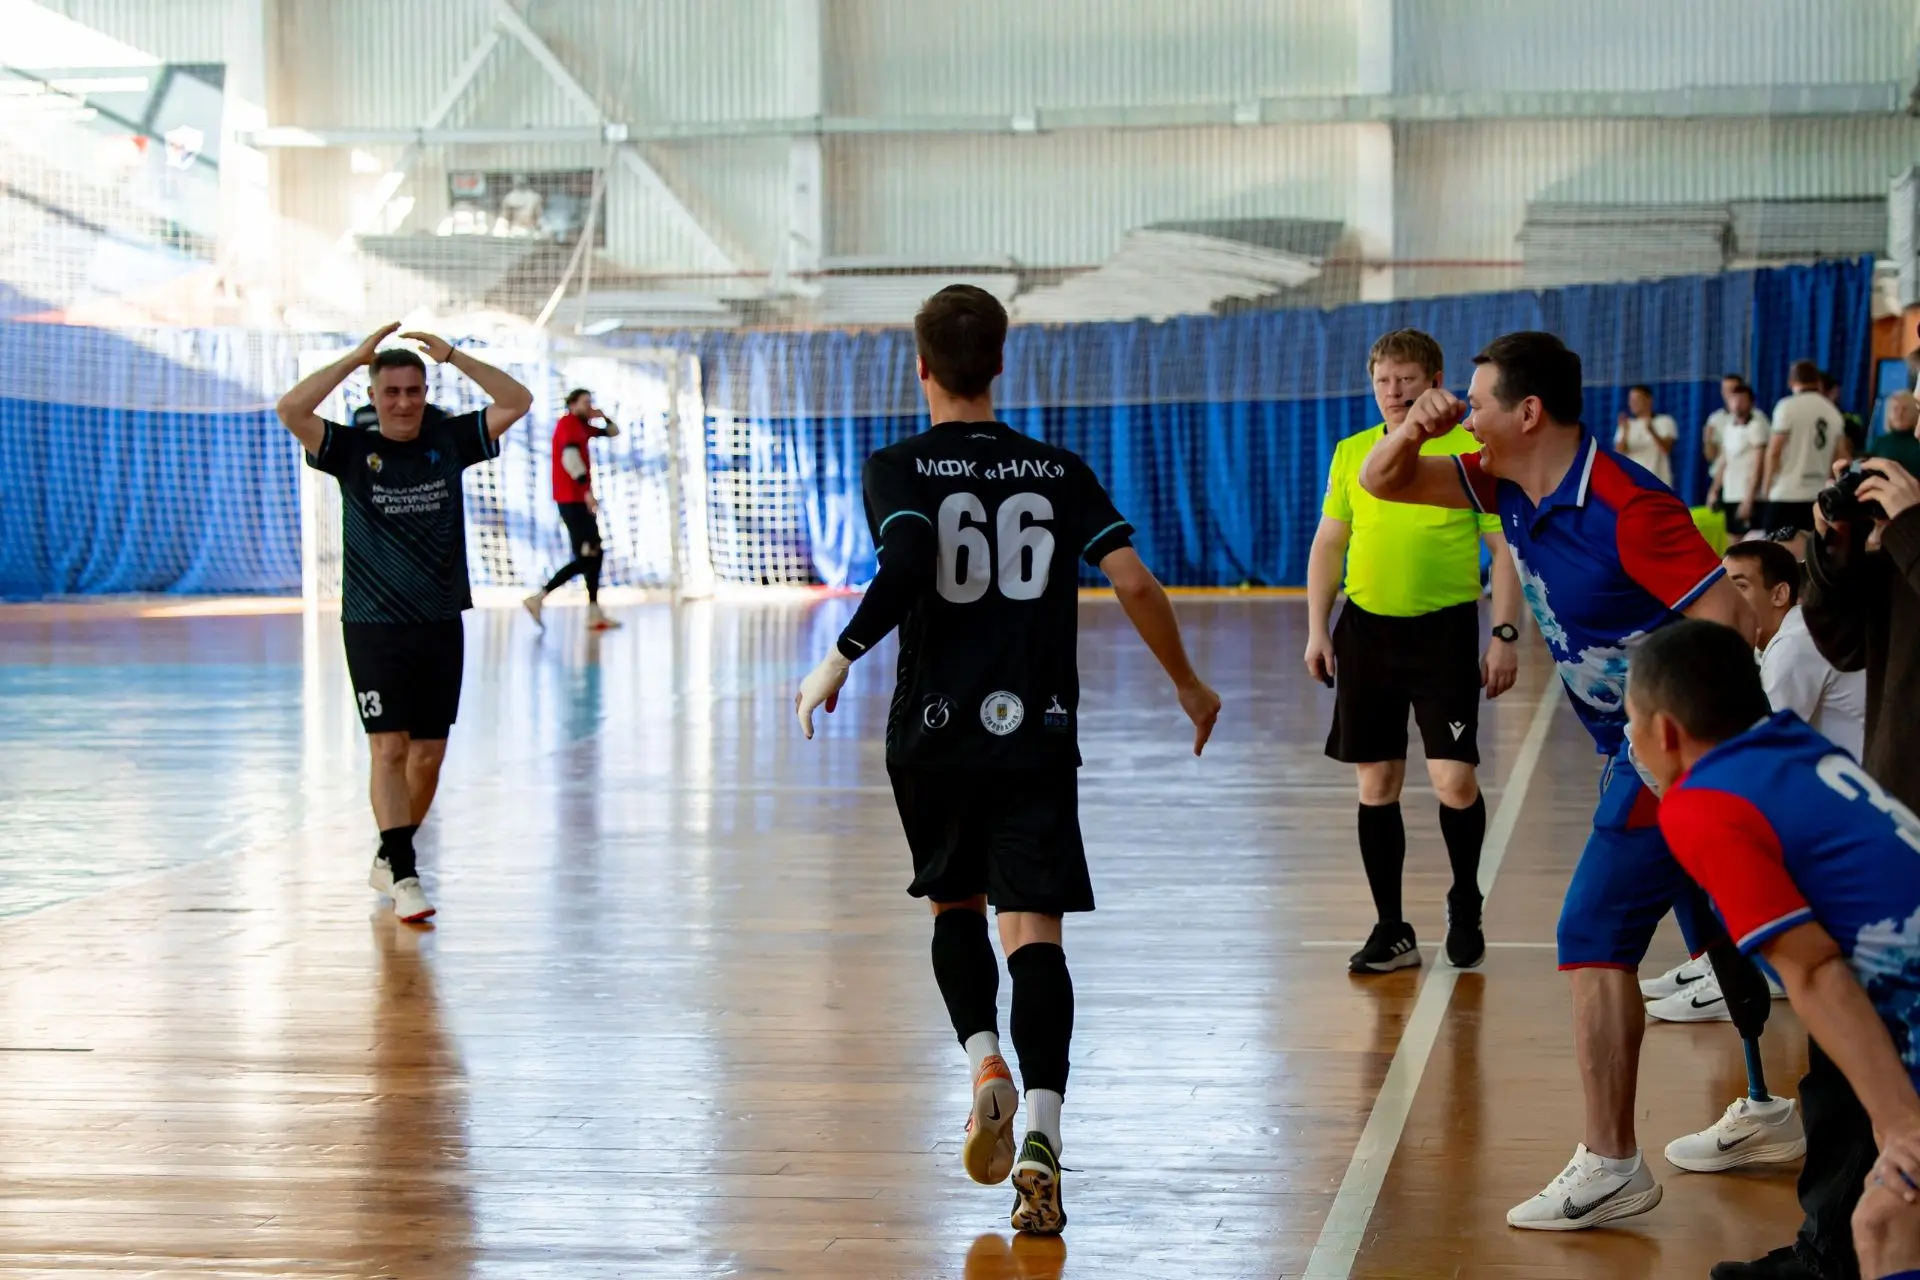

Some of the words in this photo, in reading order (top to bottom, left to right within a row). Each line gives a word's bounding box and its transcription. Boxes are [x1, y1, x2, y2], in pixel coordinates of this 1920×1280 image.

[1814, 417, 1828, 450] 8
[915, 457, 979, 479] МФК
[984, 459, 1065, 480] «НЛК»
[936, 491, 1056, 604] 66
